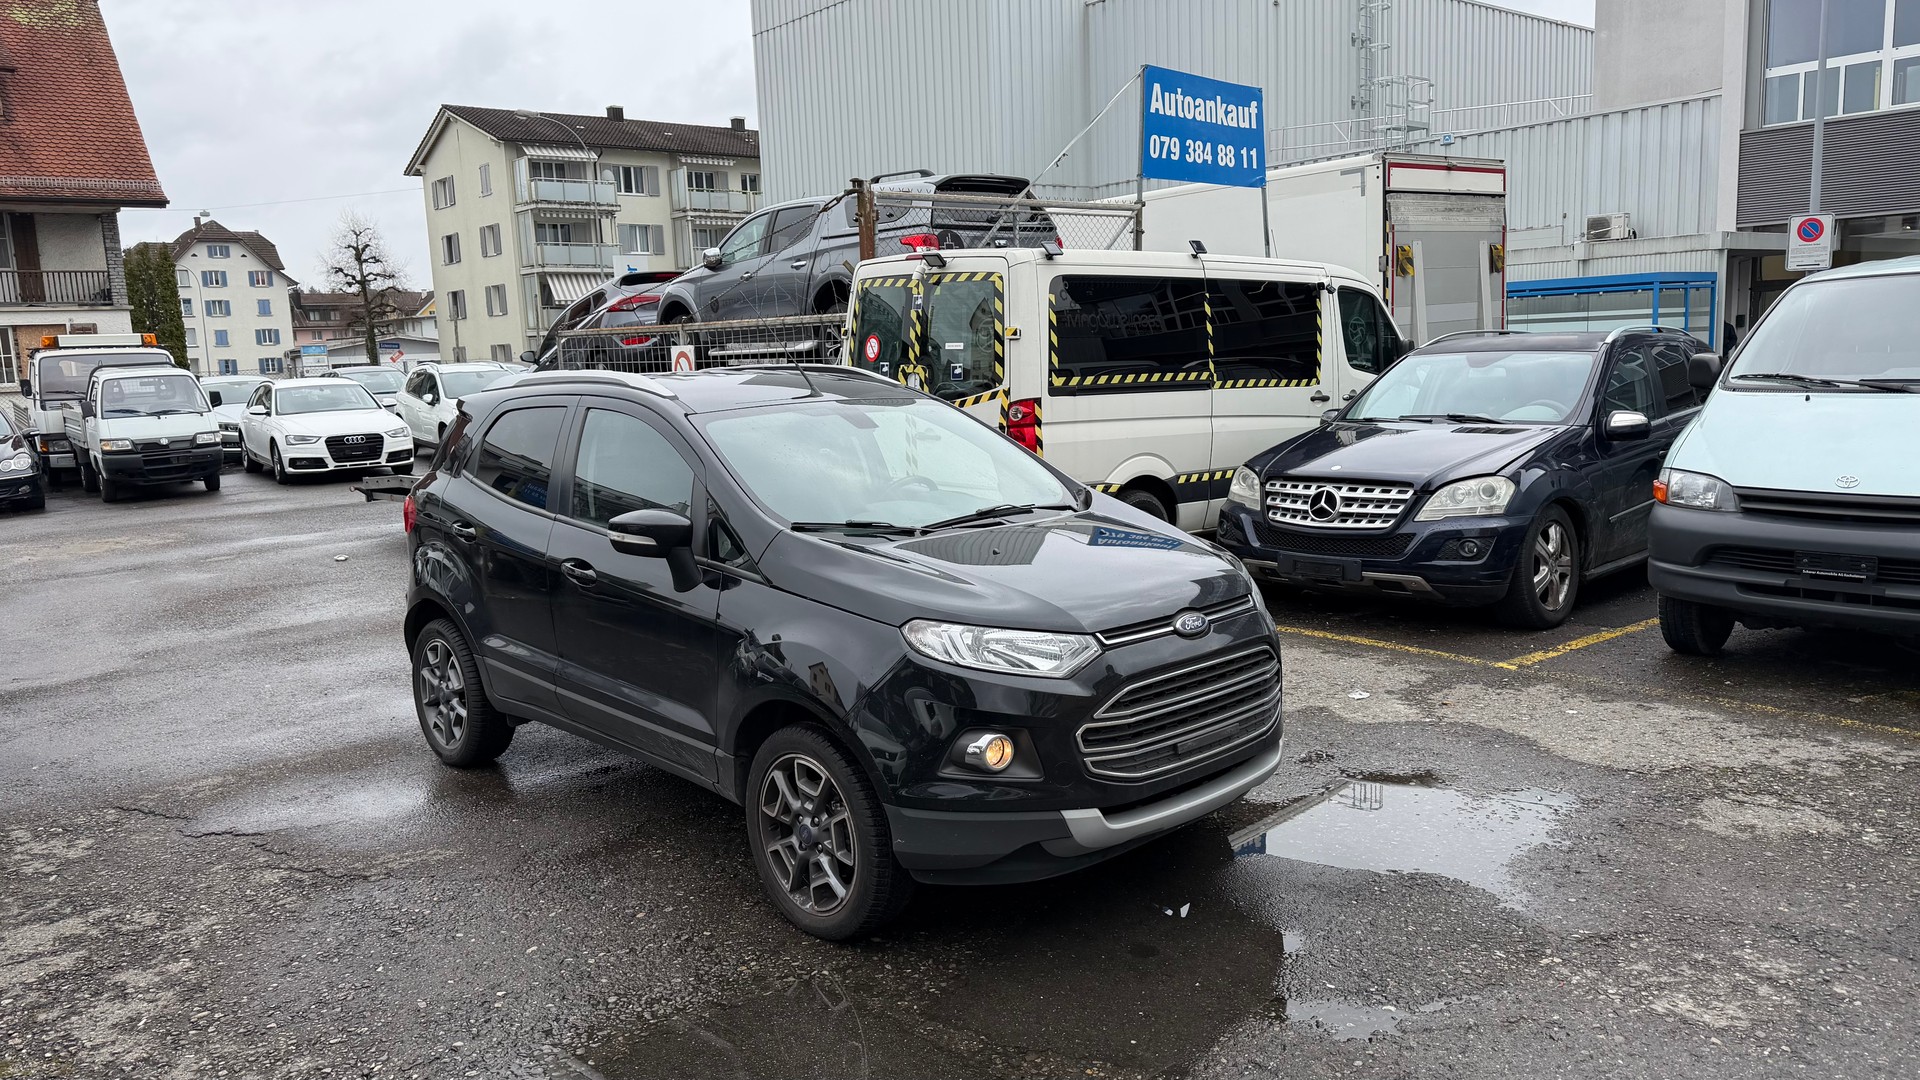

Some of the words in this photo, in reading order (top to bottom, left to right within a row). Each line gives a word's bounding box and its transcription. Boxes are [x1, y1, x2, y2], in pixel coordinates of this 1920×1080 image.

[1149, 82, 1258, 129] Autoankauf
[1149, 134, 1180, 161] 079
[1185, 139, 1213, 165] 384
[1217, 143, 1236, 168] 88
[1240, 146, 1257, 169] 11
